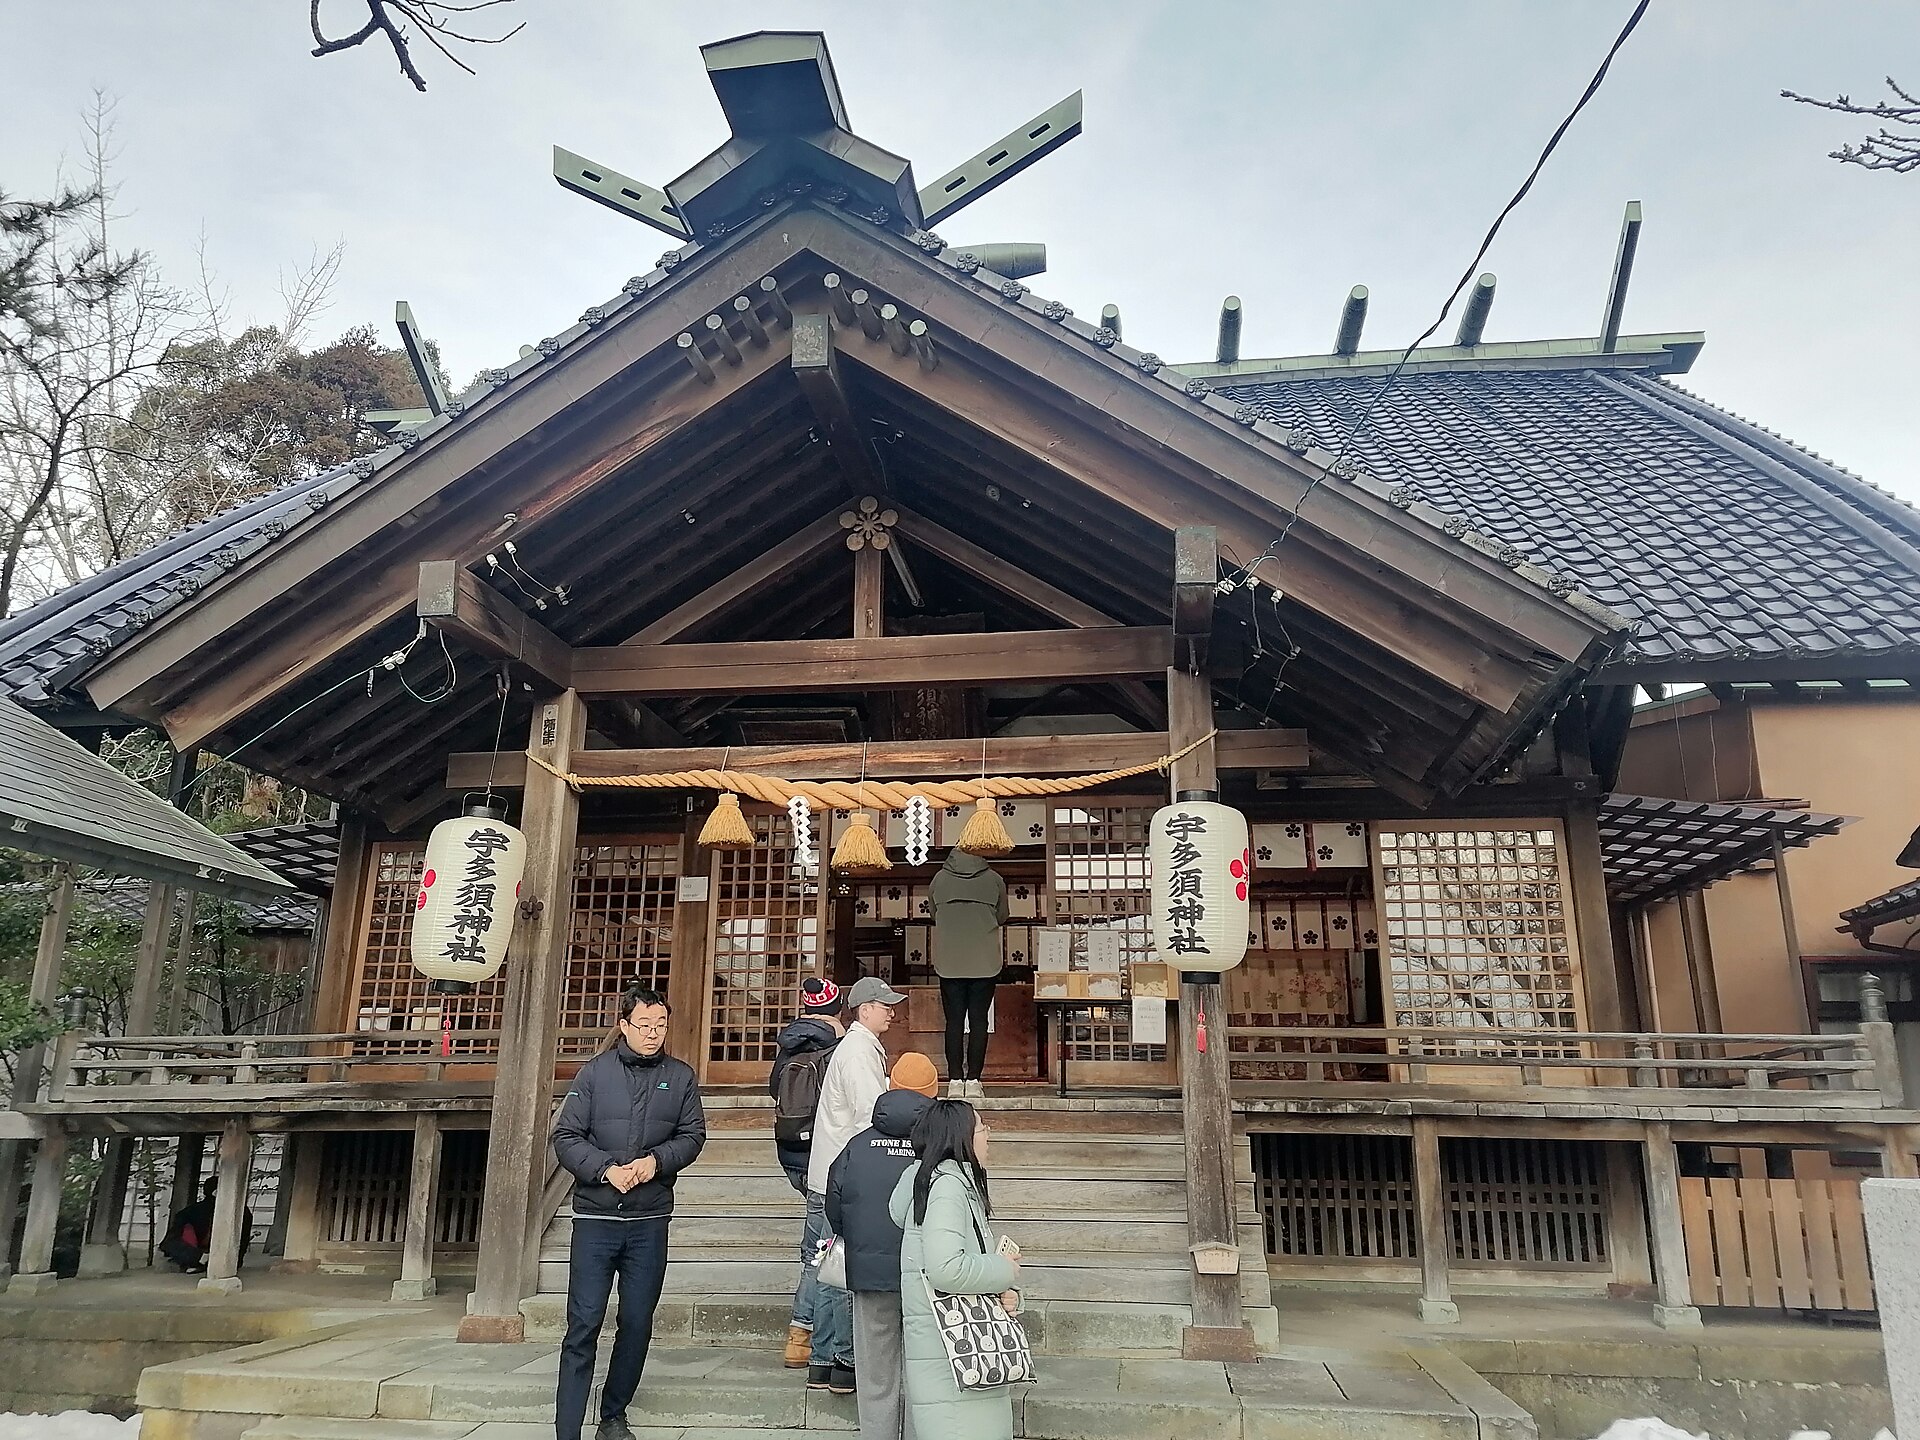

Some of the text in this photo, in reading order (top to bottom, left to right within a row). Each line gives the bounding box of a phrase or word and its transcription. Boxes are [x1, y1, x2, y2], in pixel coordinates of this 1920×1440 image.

[438, 828, 511, 965] 宇多須神社
[1164, 812, 1211, 955] 宇多須神社
[870, 1139, 900, 1147] STONE
[887, 1148, 916, 1157] MARINA
